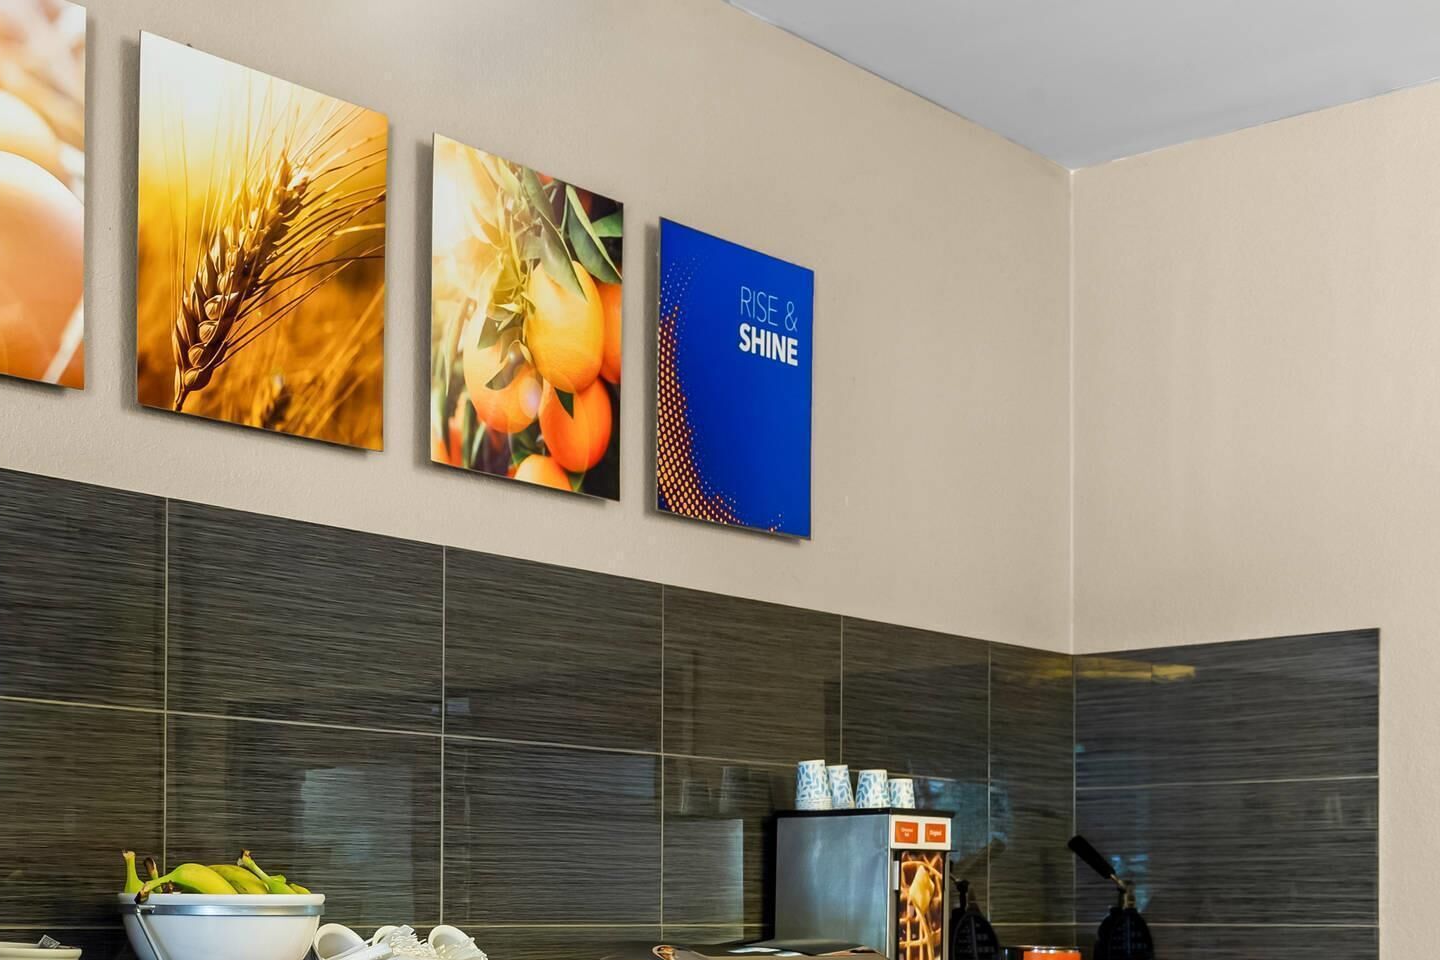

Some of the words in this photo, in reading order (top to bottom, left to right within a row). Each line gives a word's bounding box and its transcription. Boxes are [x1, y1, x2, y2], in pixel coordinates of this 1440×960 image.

[741, 286, 778, 327] RISE
[784, 301, 798, 332] &
[739, 322, 798, 367] SHINE
